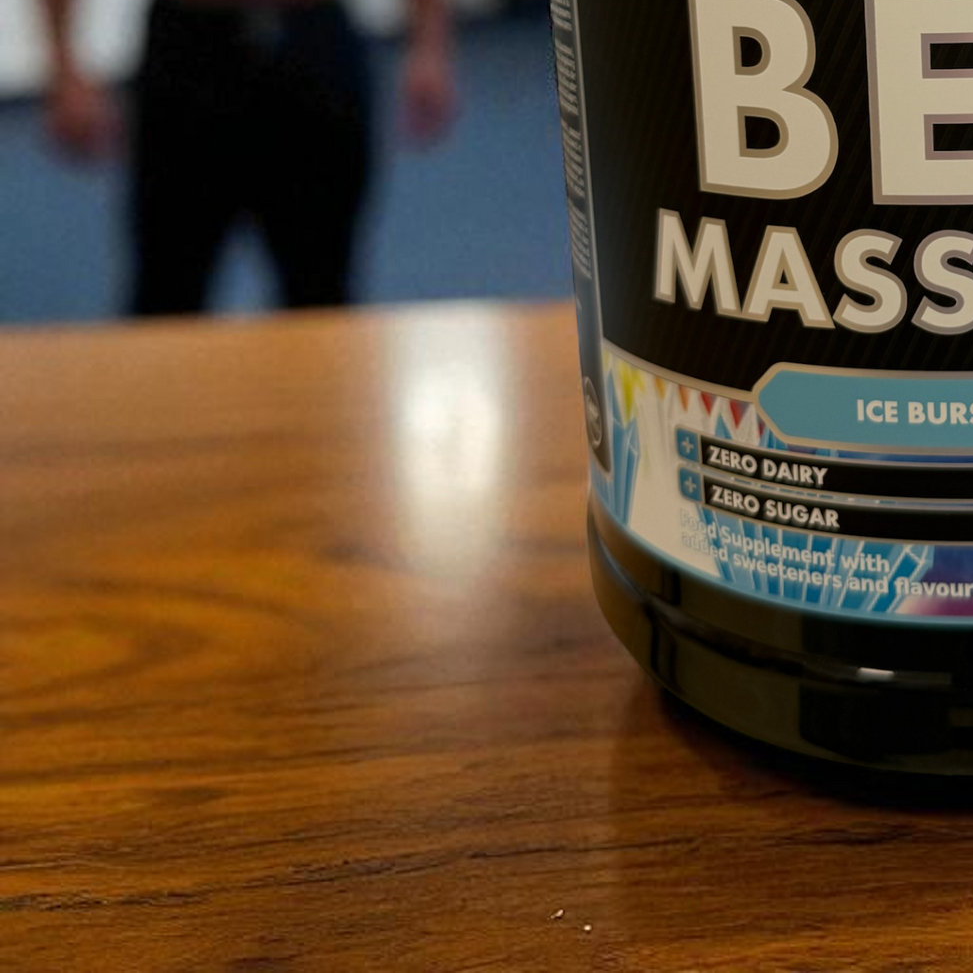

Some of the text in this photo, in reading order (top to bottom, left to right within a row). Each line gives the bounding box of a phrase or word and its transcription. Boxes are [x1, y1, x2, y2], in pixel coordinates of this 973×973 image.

[856, 399, 898, 423] ICE
[708, 445, 829, 486] ZERO DAIRY
[711, 484, 841, 528] ZERO SUGAR
[680, 508, 890, 573] Food Supplement with
[680, 532, 729, 562] added
[733, 552, 842, 588] sweeteners
[849, 576, 889, 594] and
